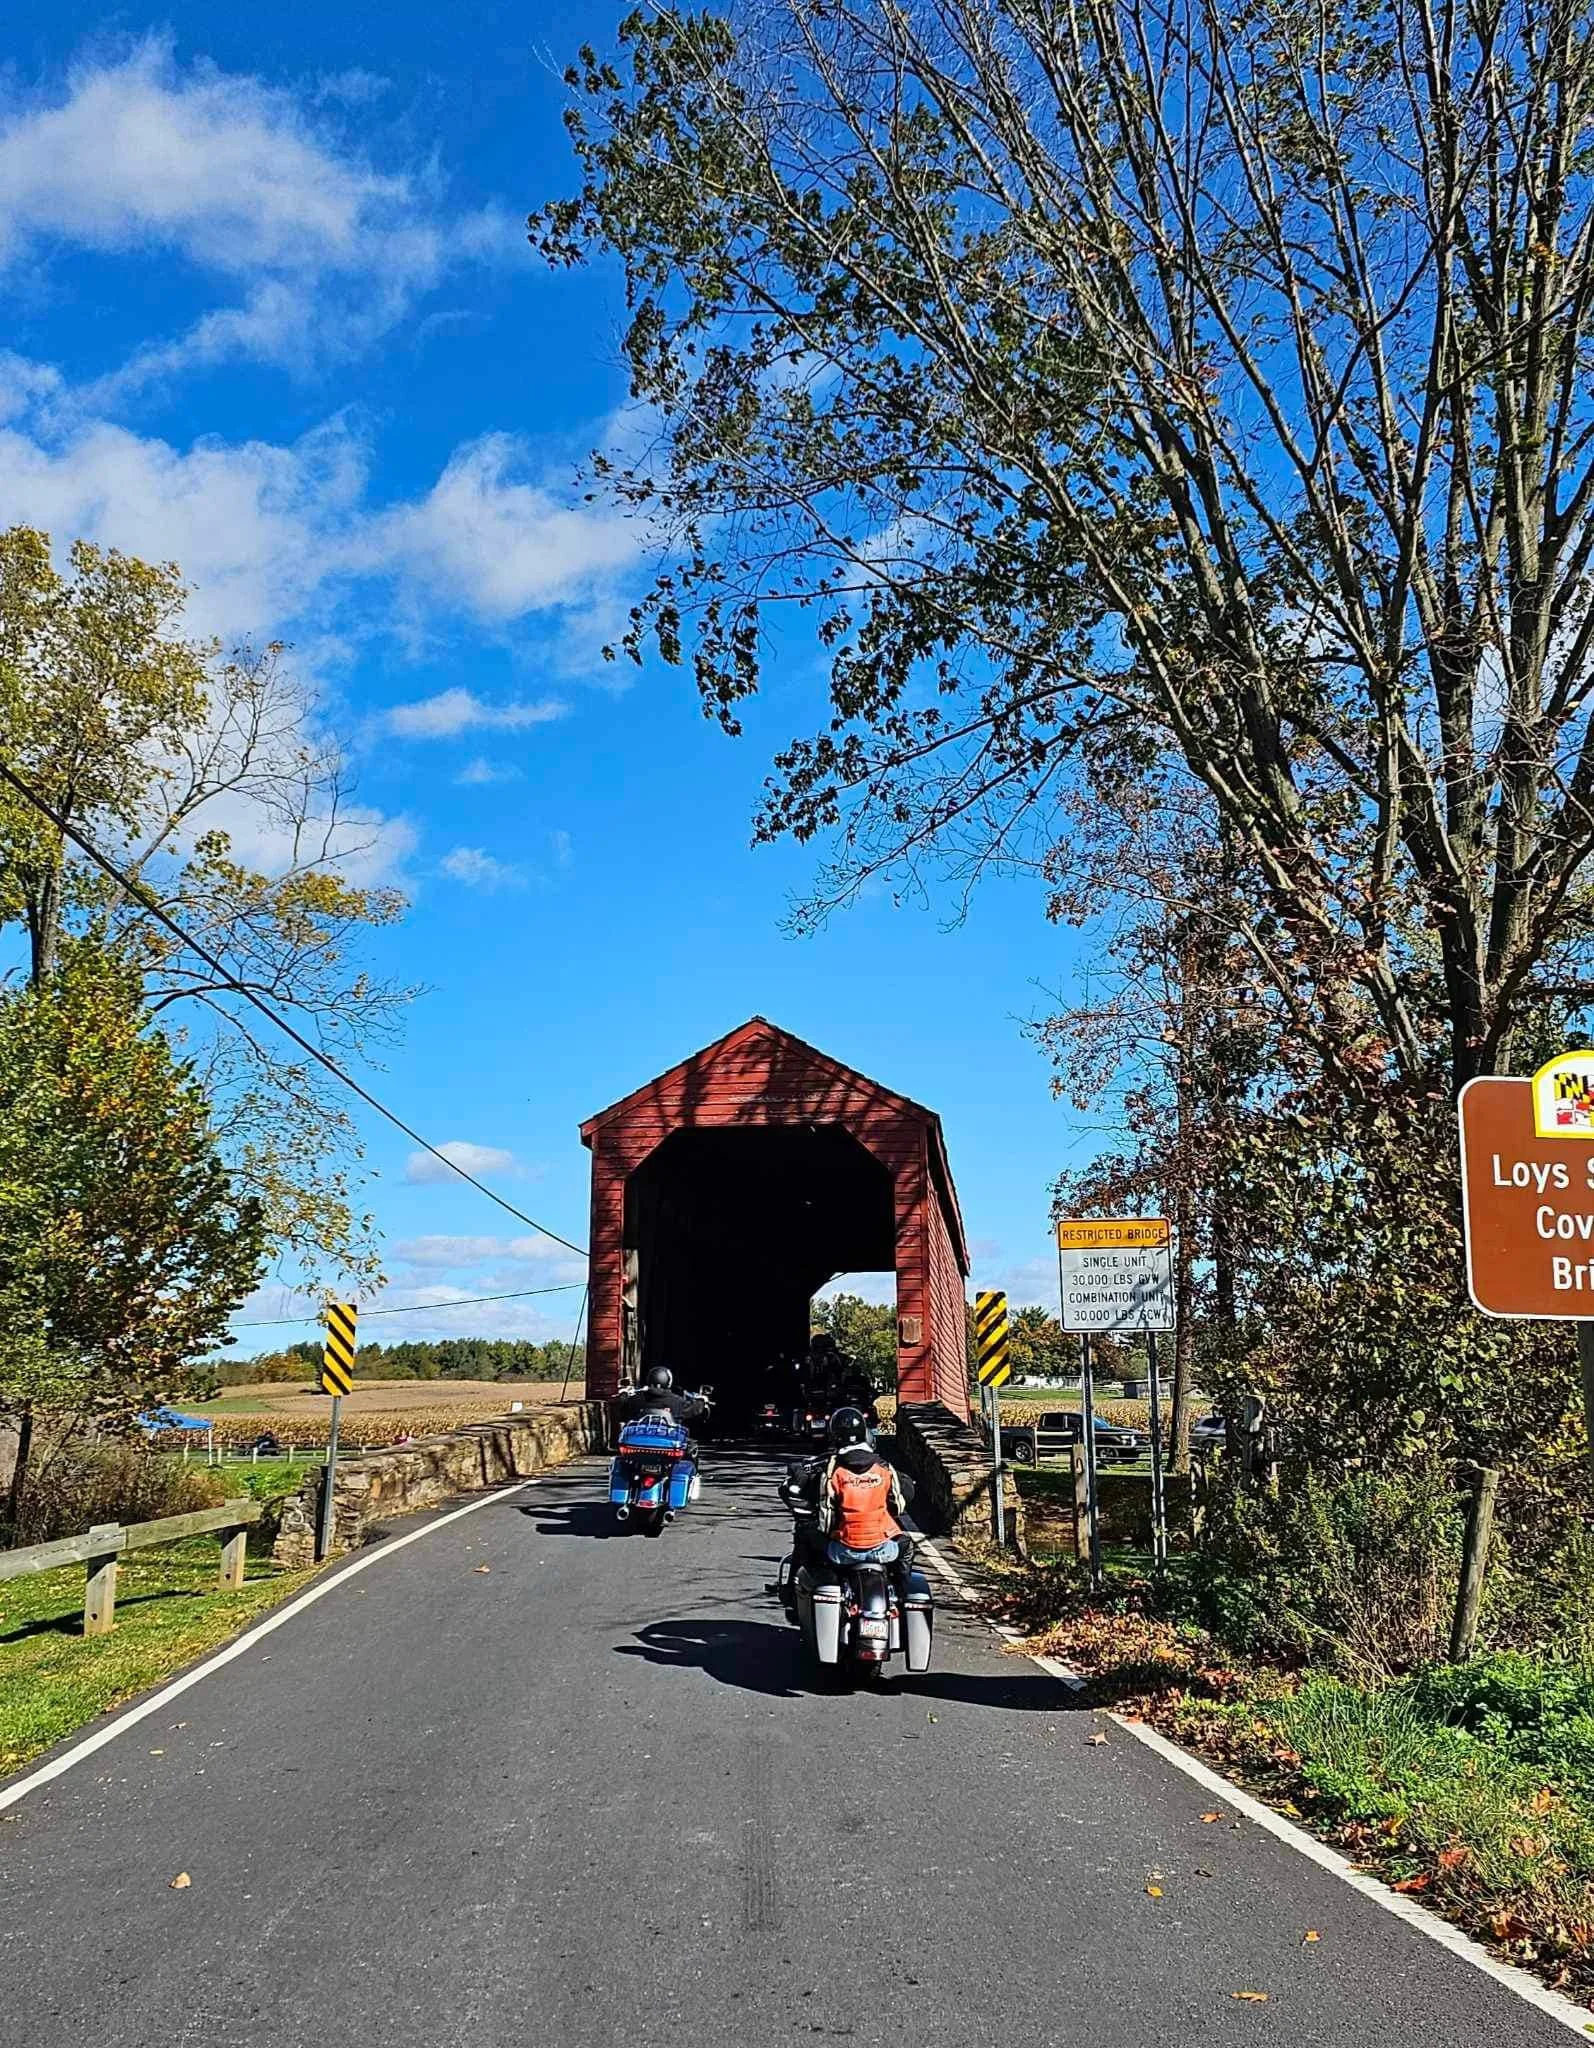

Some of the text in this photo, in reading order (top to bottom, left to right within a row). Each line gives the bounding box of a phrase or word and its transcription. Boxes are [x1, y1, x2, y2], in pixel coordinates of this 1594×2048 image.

[1492, 1153, 1570, 1194] Loys
[1063, 1228, 1164, 1241] RESTRICTED BRIDGE
[1083, 1256, 1147, 1268] SINGLE UNIT
[1072, 1273, 1160, 1286] 30,000 LBS GVW
[1069, 1291, 1164, 1304] COMBINATION UNIT
[1074, 1309, 1161, 1321] 30,000 LBS GCW
